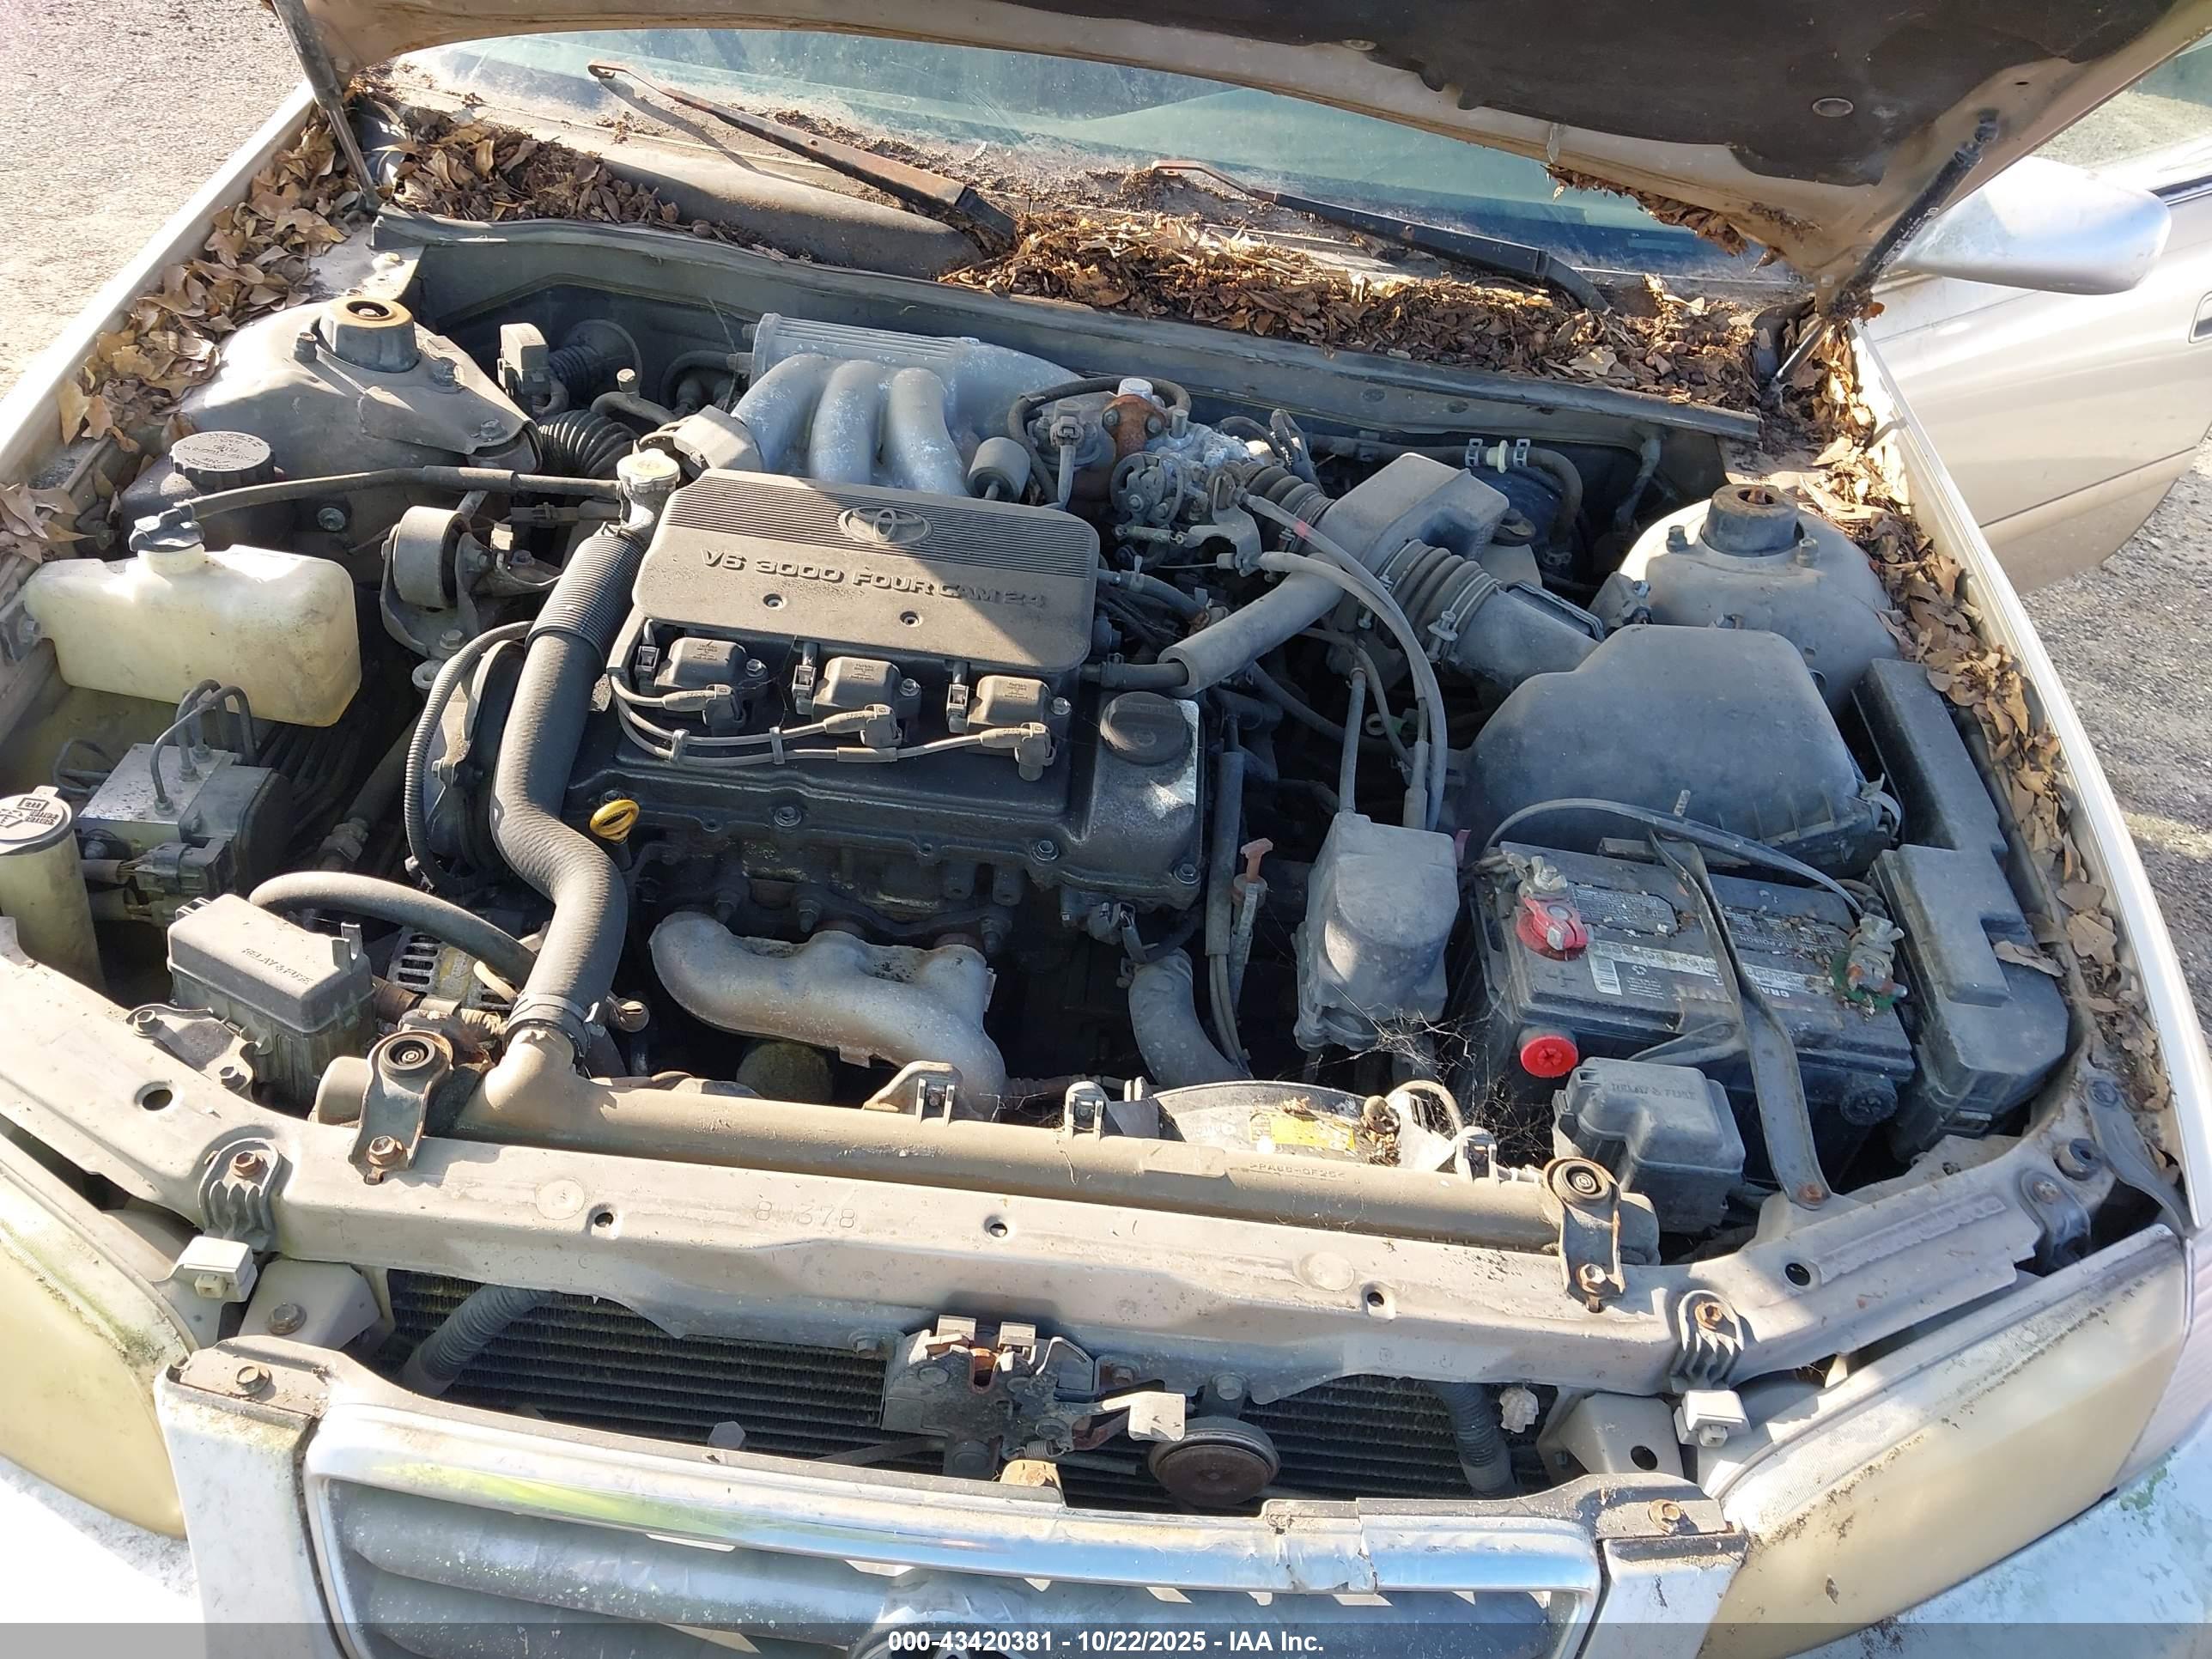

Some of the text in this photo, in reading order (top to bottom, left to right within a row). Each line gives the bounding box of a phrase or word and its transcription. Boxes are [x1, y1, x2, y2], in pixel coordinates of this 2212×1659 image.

[701, 549, 1047, 608] V6 3000 FOUR CAM 24
